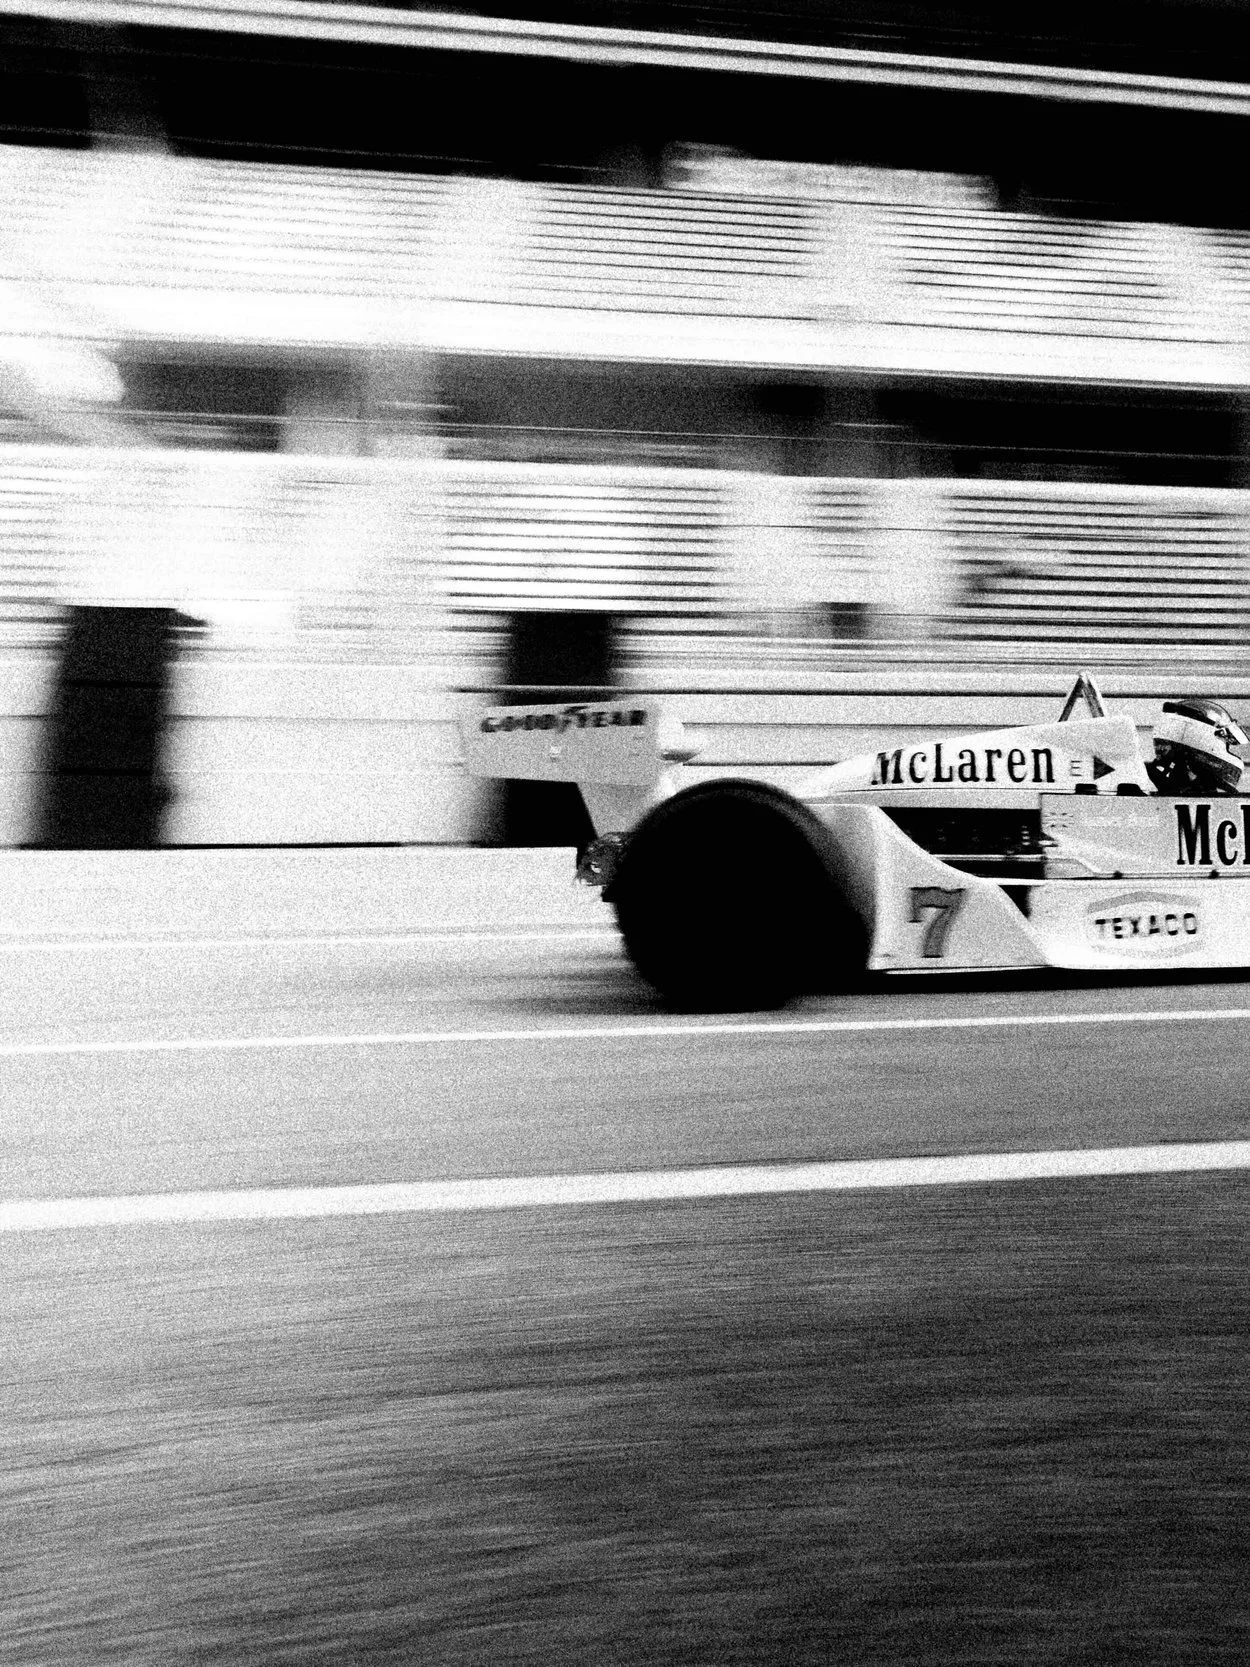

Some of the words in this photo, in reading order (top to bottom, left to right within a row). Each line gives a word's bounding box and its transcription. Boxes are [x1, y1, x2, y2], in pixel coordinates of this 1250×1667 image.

[871, 743, 1055, 786] McLaren
[908, 886, 967, 958] 7
[1095, 912, 1198, 939] TEXACO
